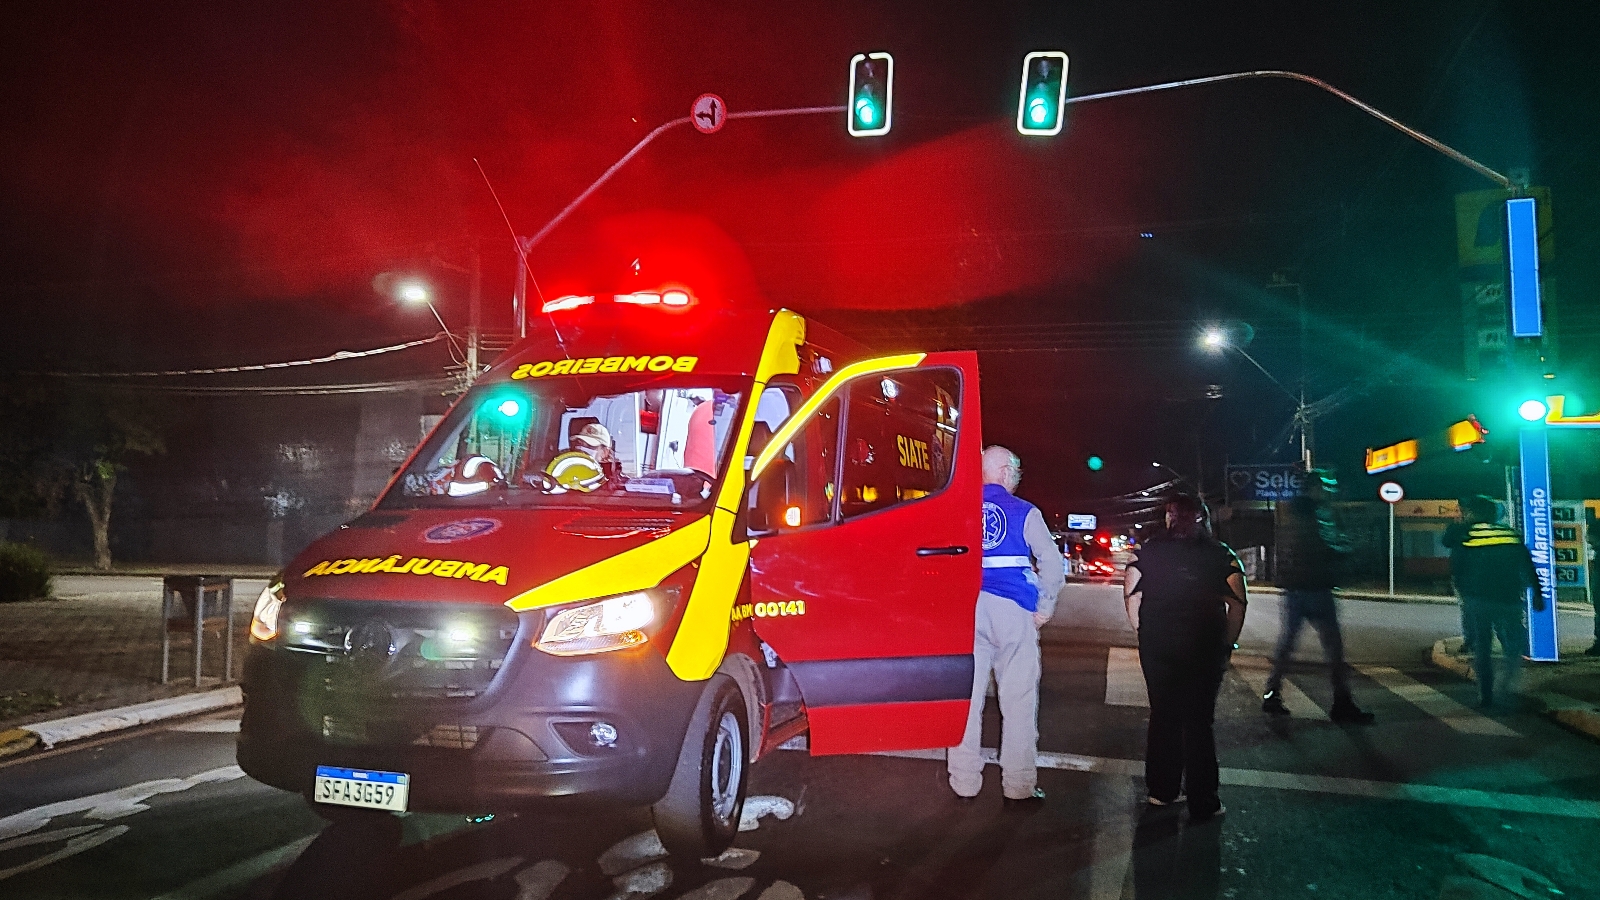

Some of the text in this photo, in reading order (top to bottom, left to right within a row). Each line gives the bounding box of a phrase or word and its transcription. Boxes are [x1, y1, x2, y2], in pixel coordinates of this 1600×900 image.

[897, 434, 930, 470] SIATE
[1530, 487, 1549, 564] Maranhão
[754, 600, 806, 617] 00141
[323, 779, 394, 805] SFA3G59
